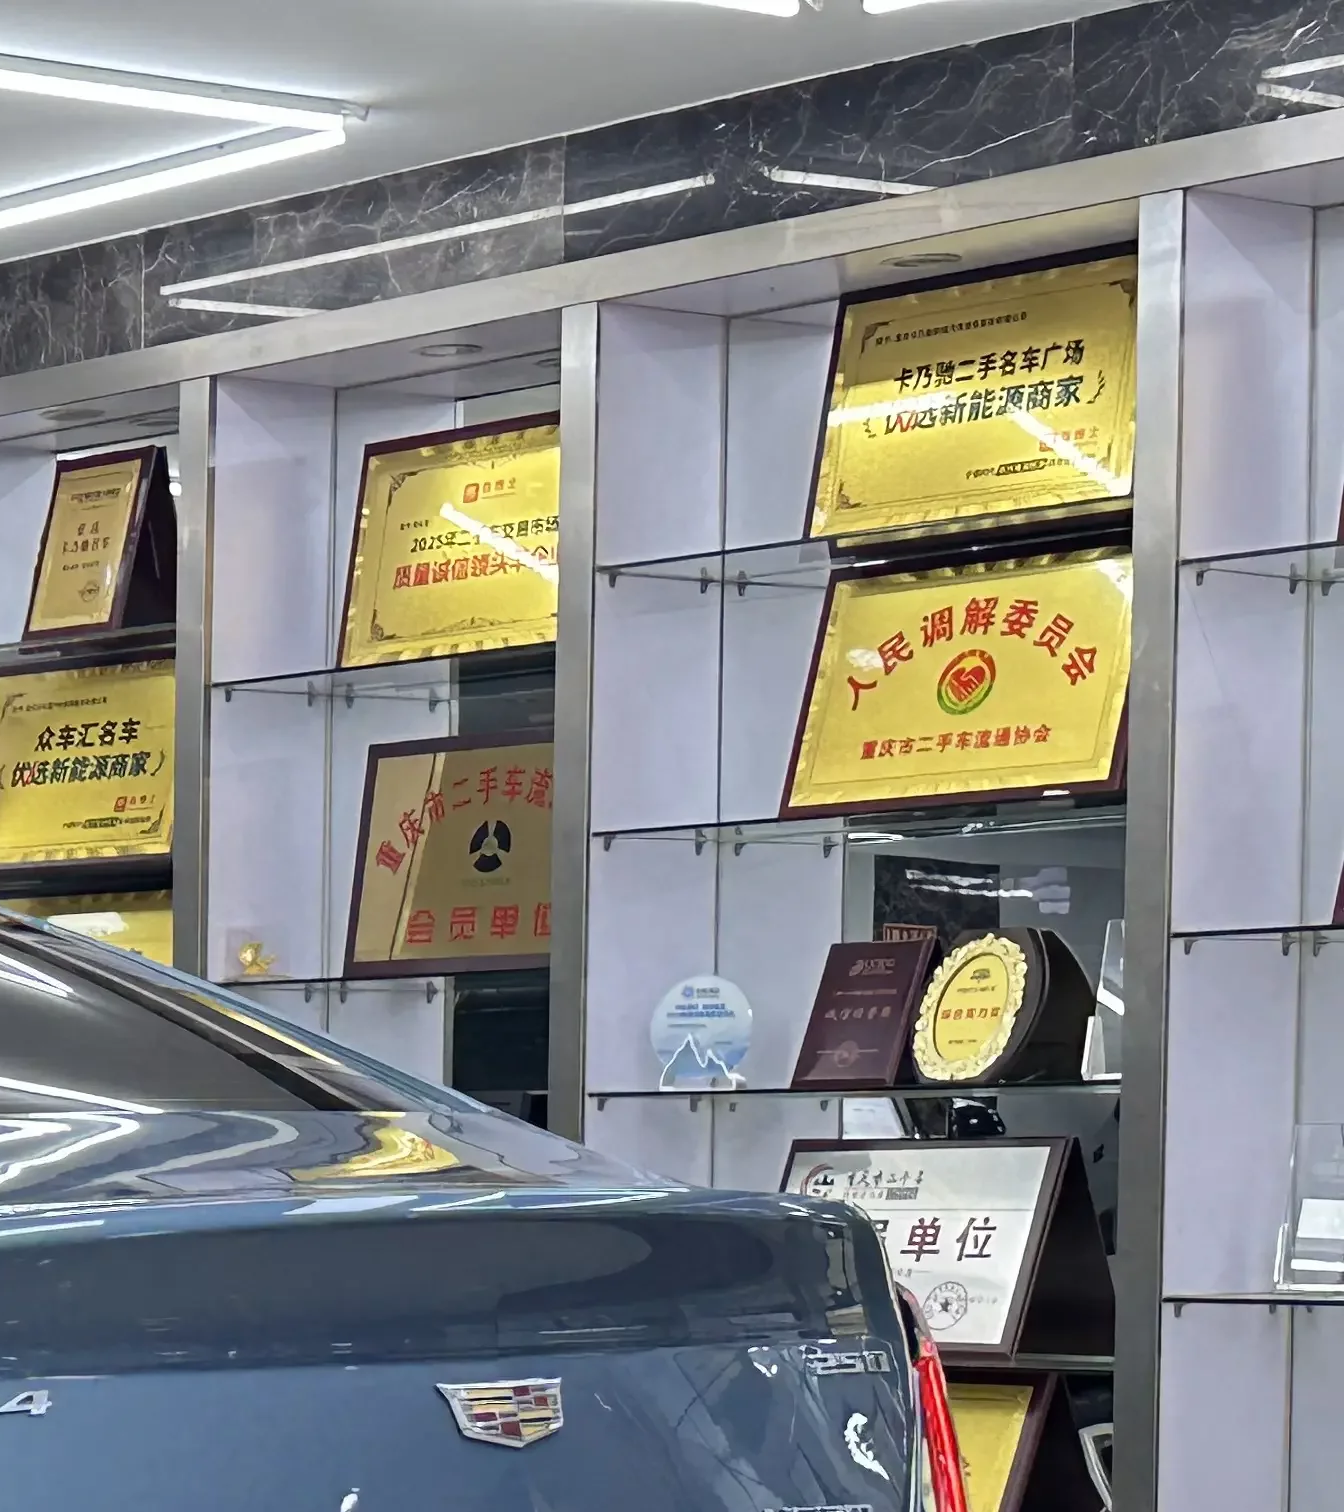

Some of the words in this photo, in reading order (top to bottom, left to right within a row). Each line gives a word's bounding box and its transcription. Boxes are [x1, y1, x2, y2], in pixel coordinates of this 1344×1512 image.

[894, 339, 1085, 394] 卡乃驰二手名车广场
[847, 596, 1098, 711] 人民调解委员会
[34, 718, 141, 752] 众车汇名车
[860, 724, 1052, 760] 重庆市二手车流通协会
